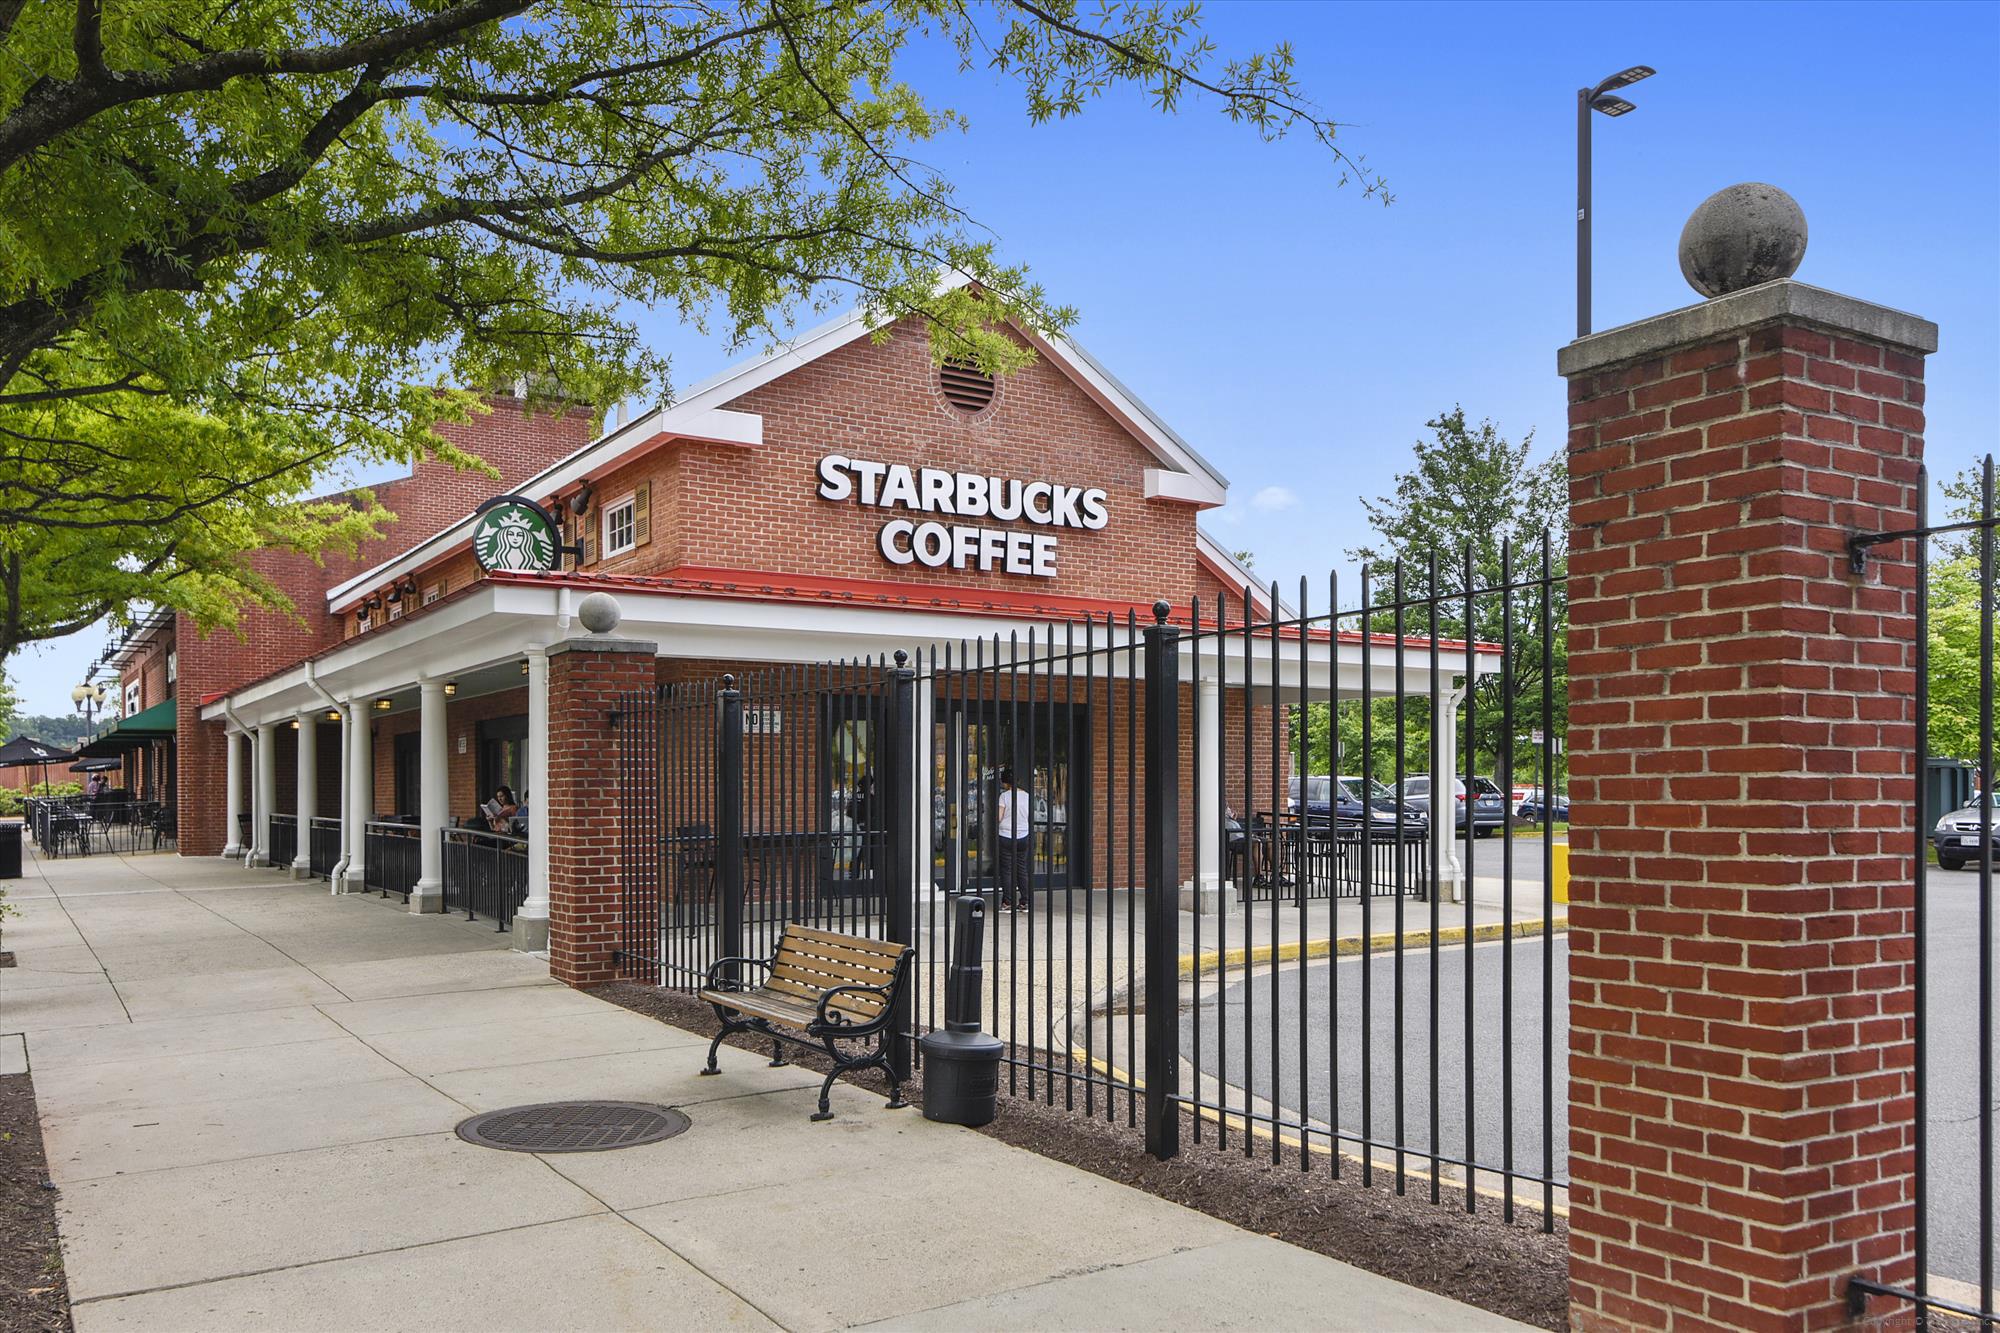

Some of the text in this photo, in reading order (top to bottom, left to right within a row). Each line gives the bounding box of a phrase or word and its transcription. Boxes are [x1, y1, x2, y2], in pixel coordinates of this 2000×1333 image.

[818, 454, 1109, 530] STARBUCKS
[879, 519, 1058, 577] COFFEE
[745, 713, 758, 725] NO
